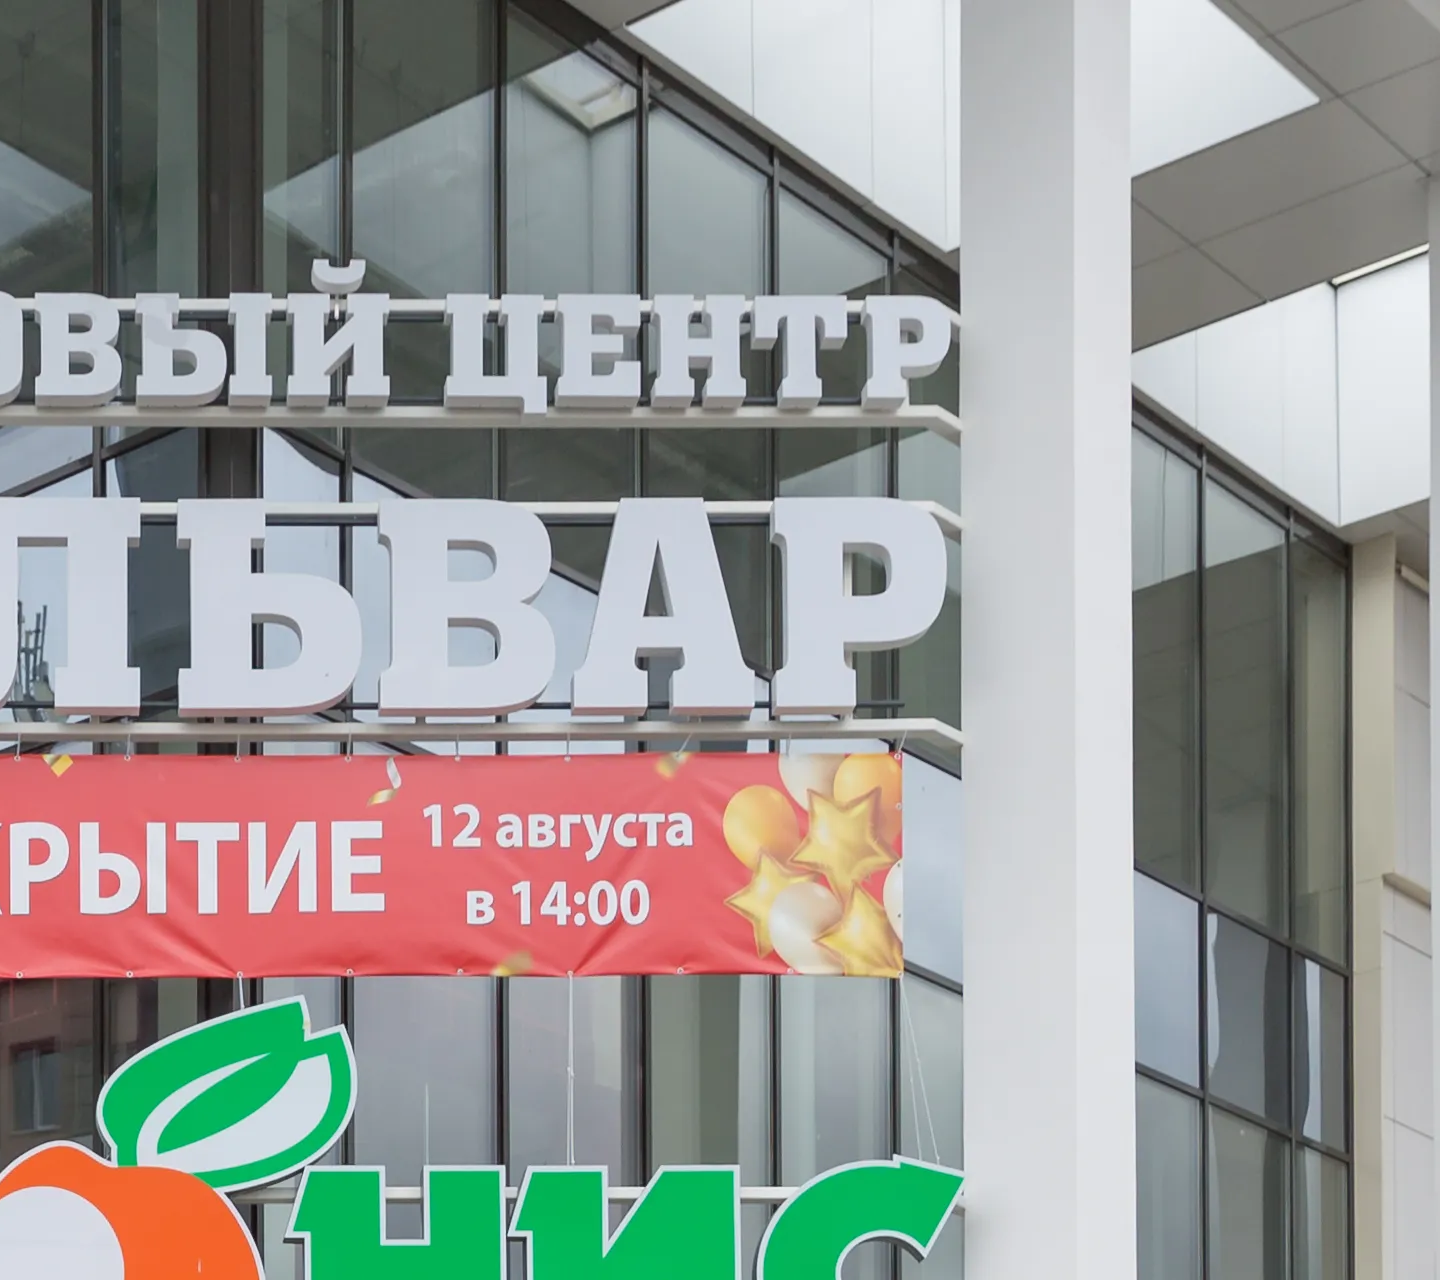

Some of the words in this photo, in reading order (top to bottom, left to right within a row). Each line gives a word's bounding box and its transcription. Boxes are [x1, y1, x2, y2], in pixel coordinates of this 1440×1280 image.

[443, 290, 953, 415] ЦЕНТР
[424, 803, 481, 848] 12
[496, 809, 695, 859] августа
[466, 892, 497, 927] в
[511, 879, 651, 928] 14:00
